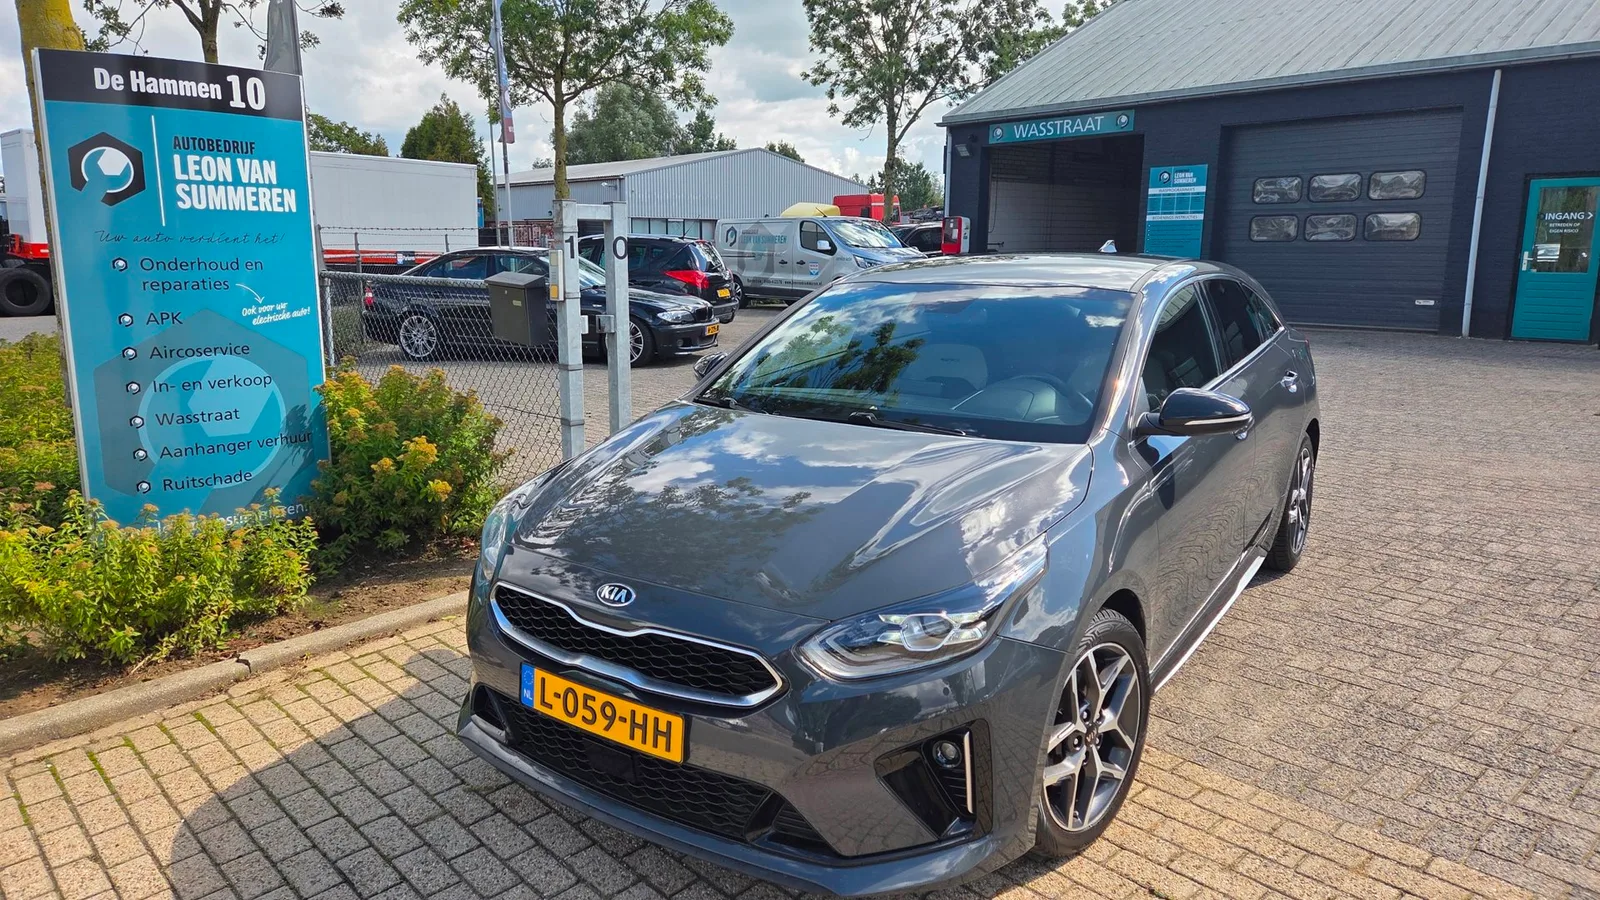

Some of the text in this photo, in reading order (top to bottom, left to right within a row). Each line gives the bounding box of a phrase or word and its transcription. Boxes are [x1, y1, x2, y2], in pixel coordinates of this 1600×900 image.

[93, 67, 266, 111] De Hammen 10
[1013, 115, 1104, 139] WASSTRAAT
[173, 135, 256, 155] AUTOBEDRIJF
[173, 154, 277, 185] LEON VAN
[175, 183, 297, 213] SUMMEREN
[1545, 212, 1585, 220] INGANG
[94, 230, 286, 244] Uw auto verdient het!
[140, 257, 264, 272] Onderhoud en
[142, 278, 230, 294] reparaties
[242, 302, 288, 317] Ook voor uw
[146, 312, 183, 326] APK
[149, 343, 250, 360] Aircoservice
[153, 374, 272, 393] In- en verkoop
[155, 408, 240, 426] Wasstraat
[159, 431, 312, 459] Aanhanger verhuur
[162, 470, 252, 492] Ruitschade
[600, 585, 627, 603] KIA
[523, 689, 533, 700] NL
[540, 676, 672, 753] L-059-HH
